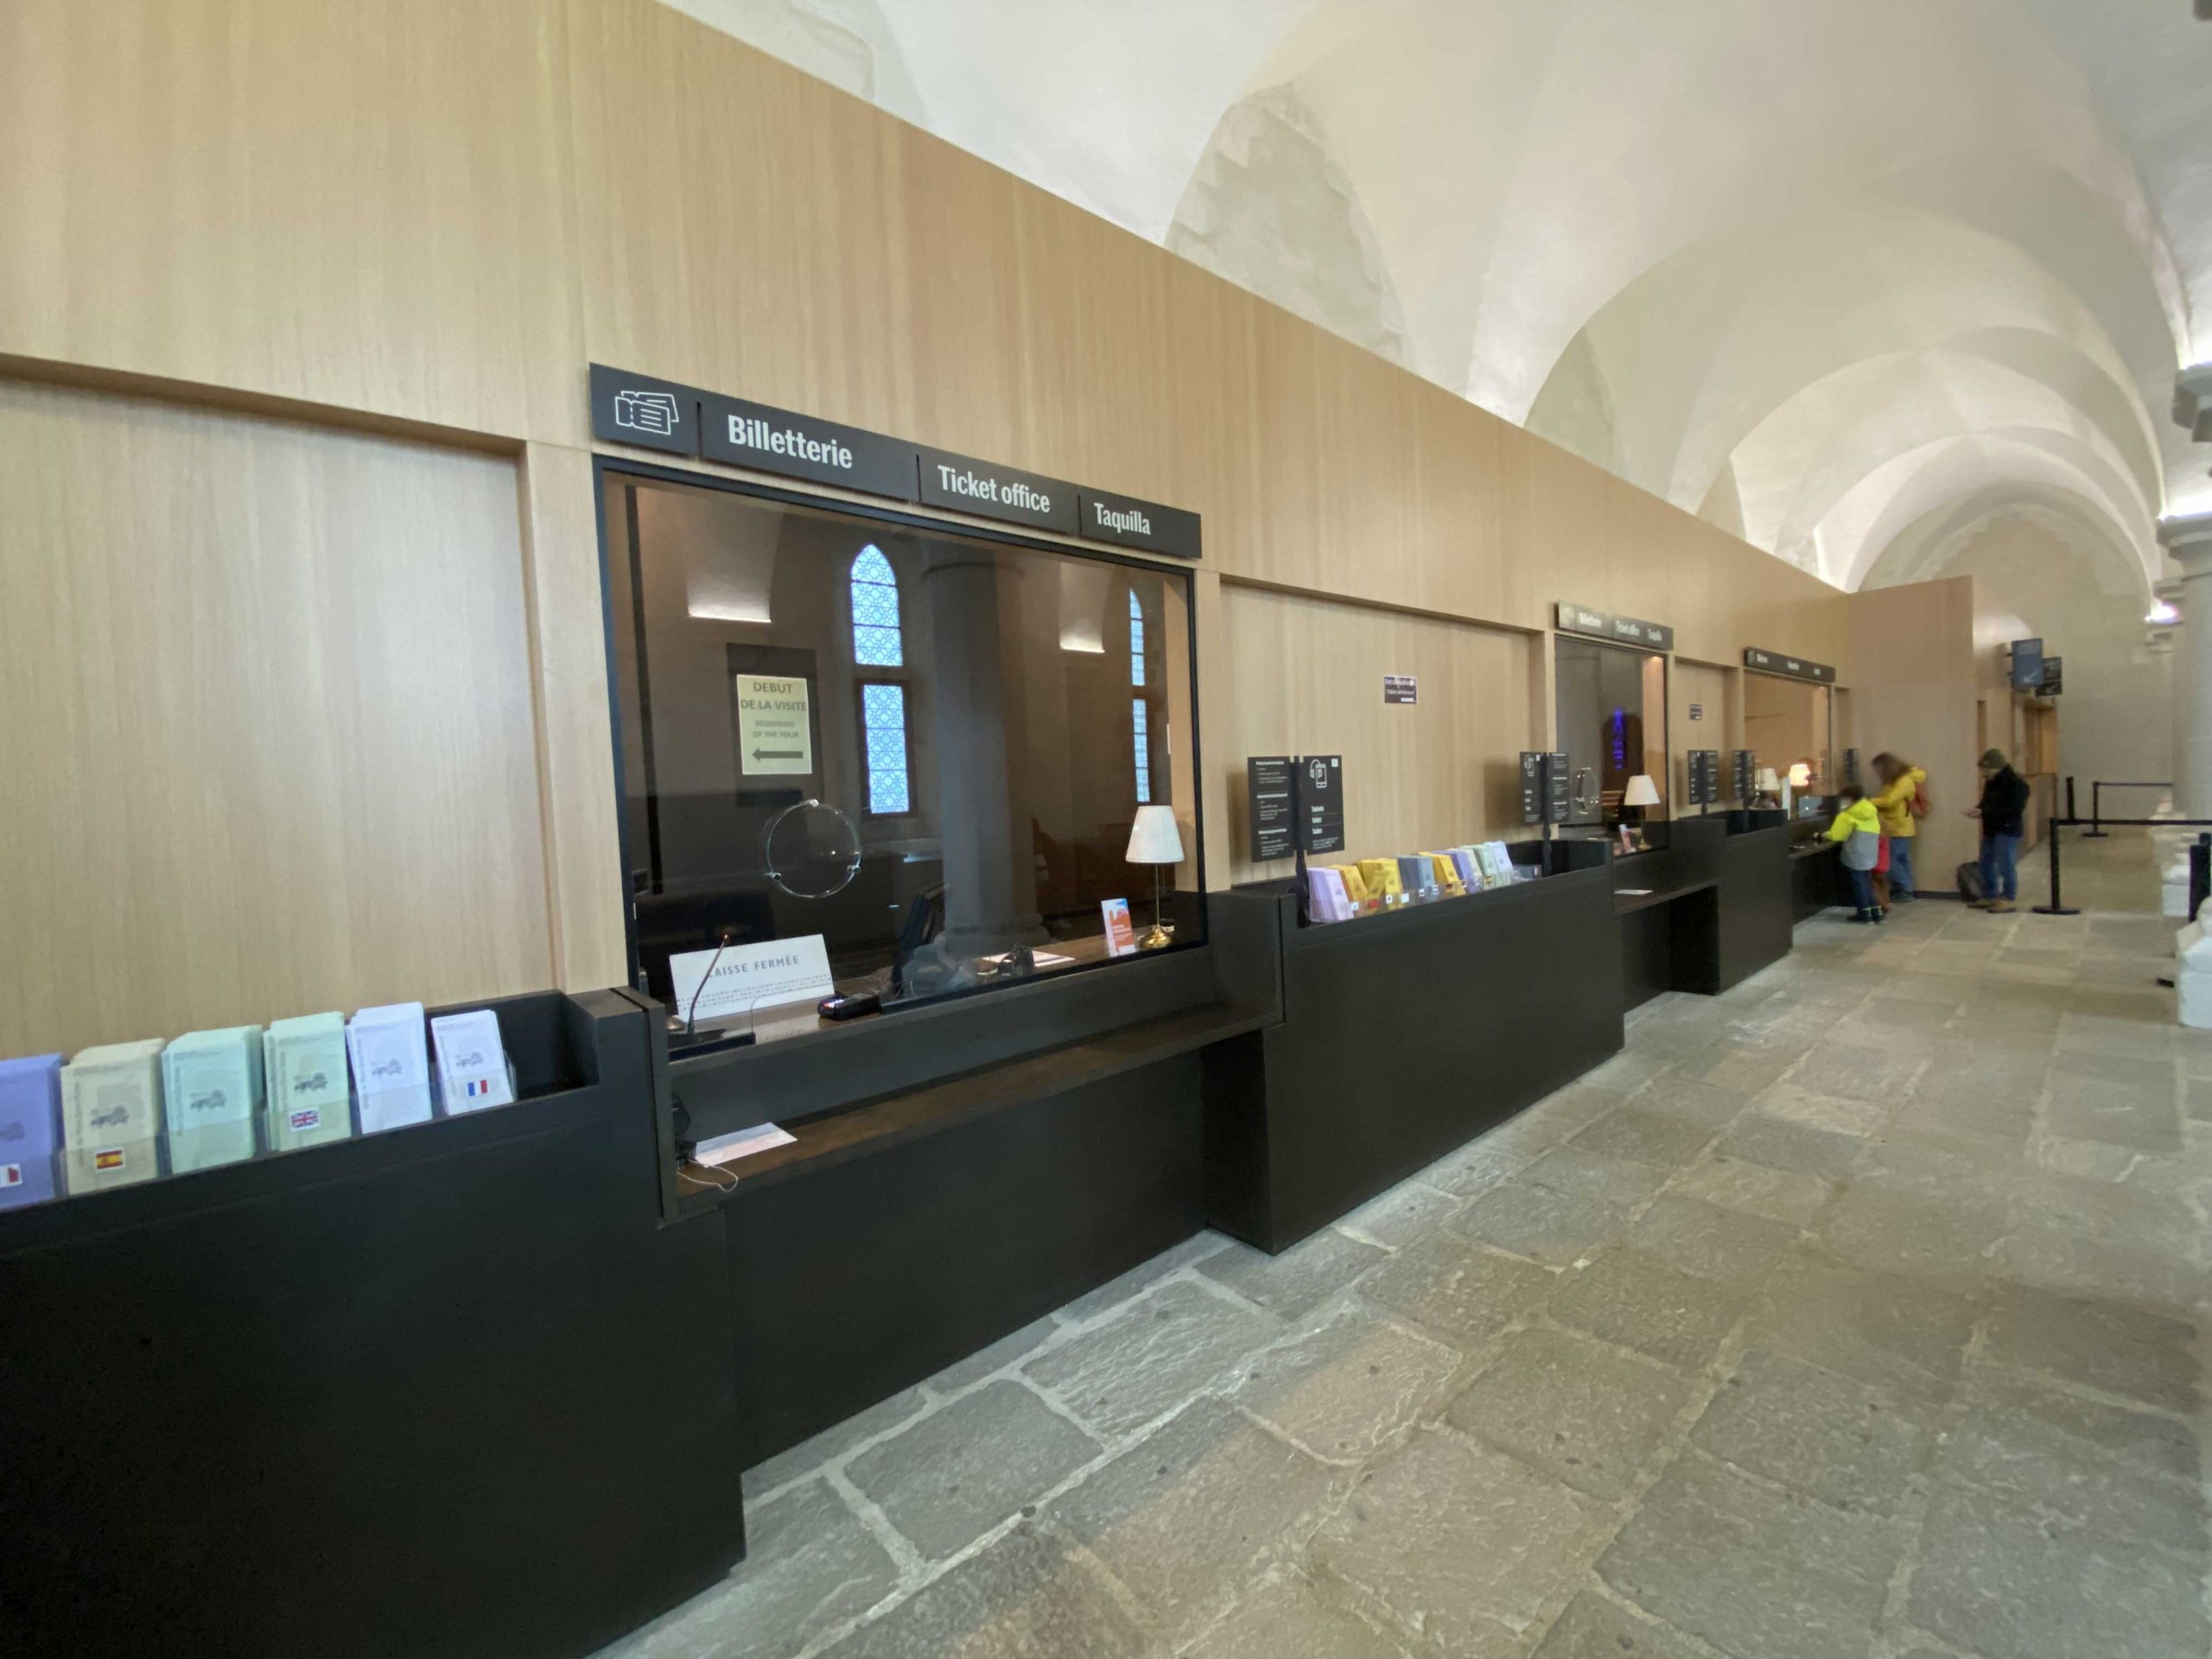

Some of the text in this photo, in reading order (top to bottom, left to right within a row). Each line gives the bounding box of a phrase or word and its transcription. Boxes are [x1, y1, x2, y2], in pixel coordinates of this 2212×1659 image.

[727, 415, 853, 469] Billetterie
[937, 466, 1051, 514] Ticket office
[1094, 502, 1151, 537] Taquilla
[741, 700, 807, 711] DE LA VISITE
[754, 954, 800, 971] FERMÉE
